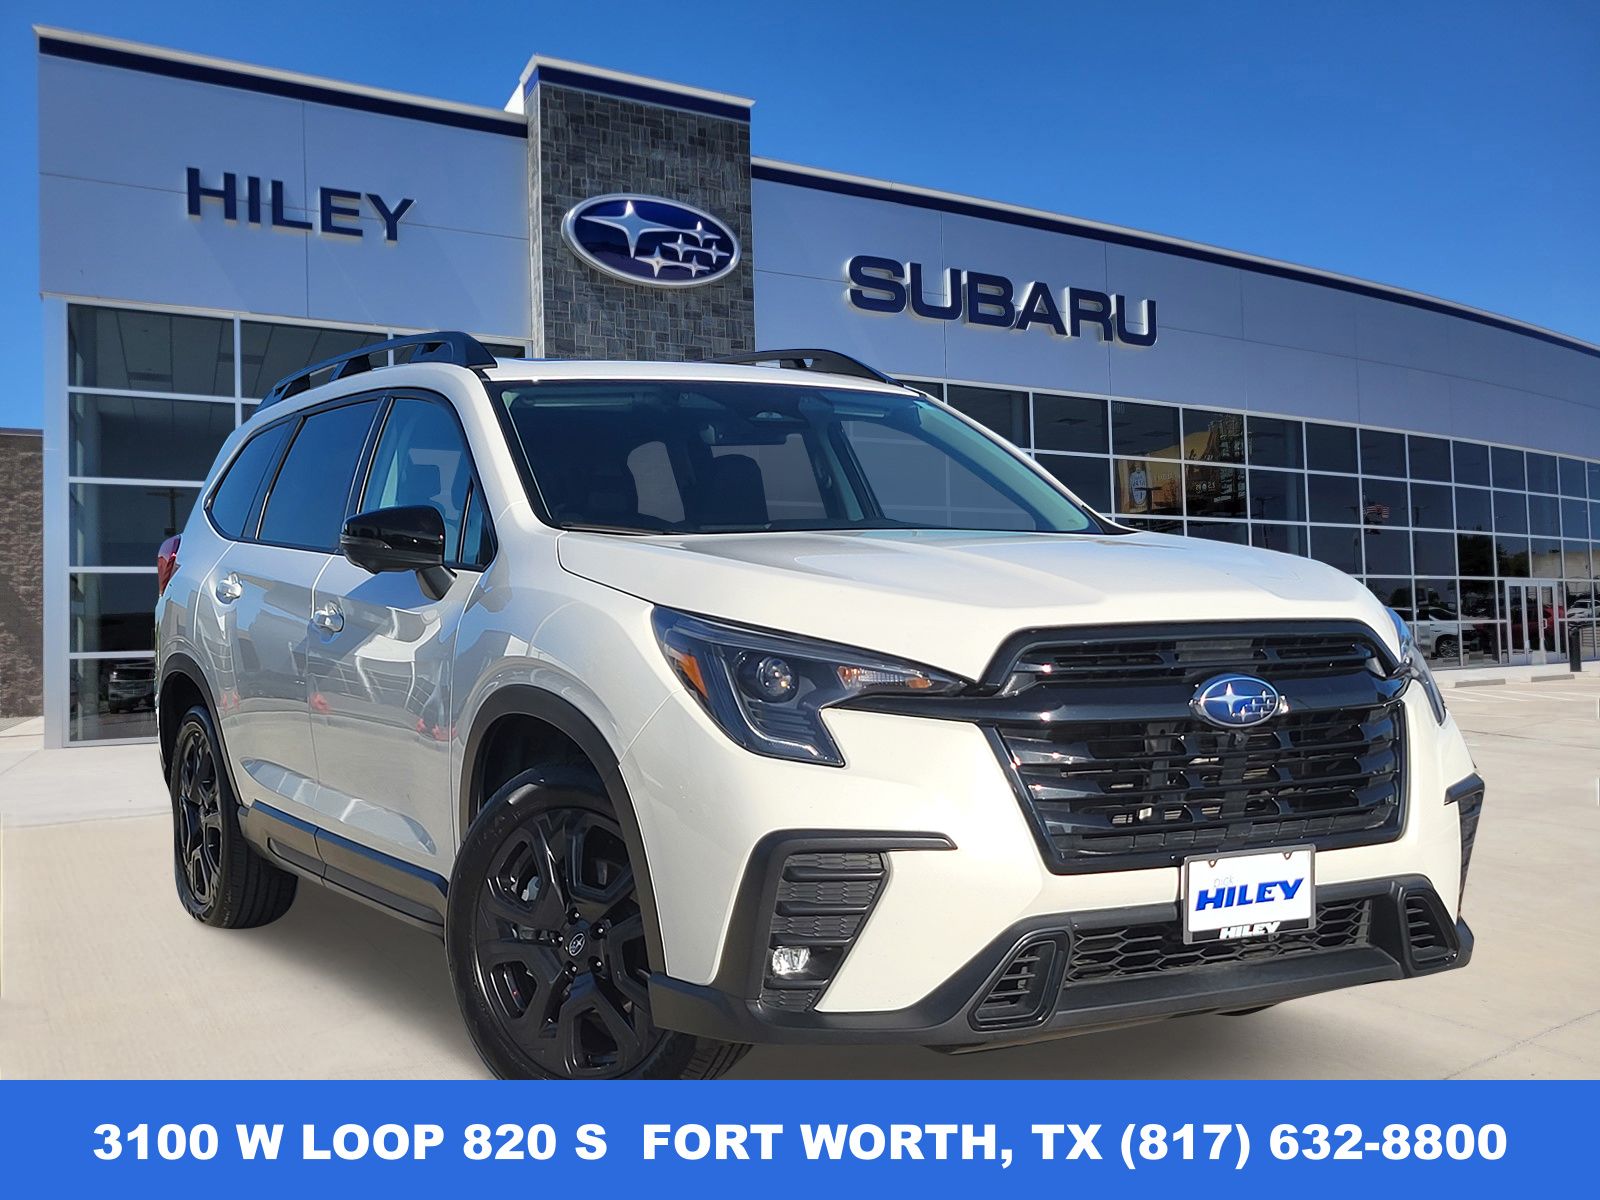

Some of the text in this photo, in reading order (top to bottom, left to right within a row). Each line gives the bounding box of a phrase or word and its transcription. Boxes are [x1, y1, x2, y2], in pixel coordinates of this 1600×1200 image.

[186, 166, 416, 242] HILEY
[847, 254, 1158, 347] SUBARU
[1195, 877, 1304, 912] HILEY
[1219, 920, 1281, 940] HILEY
